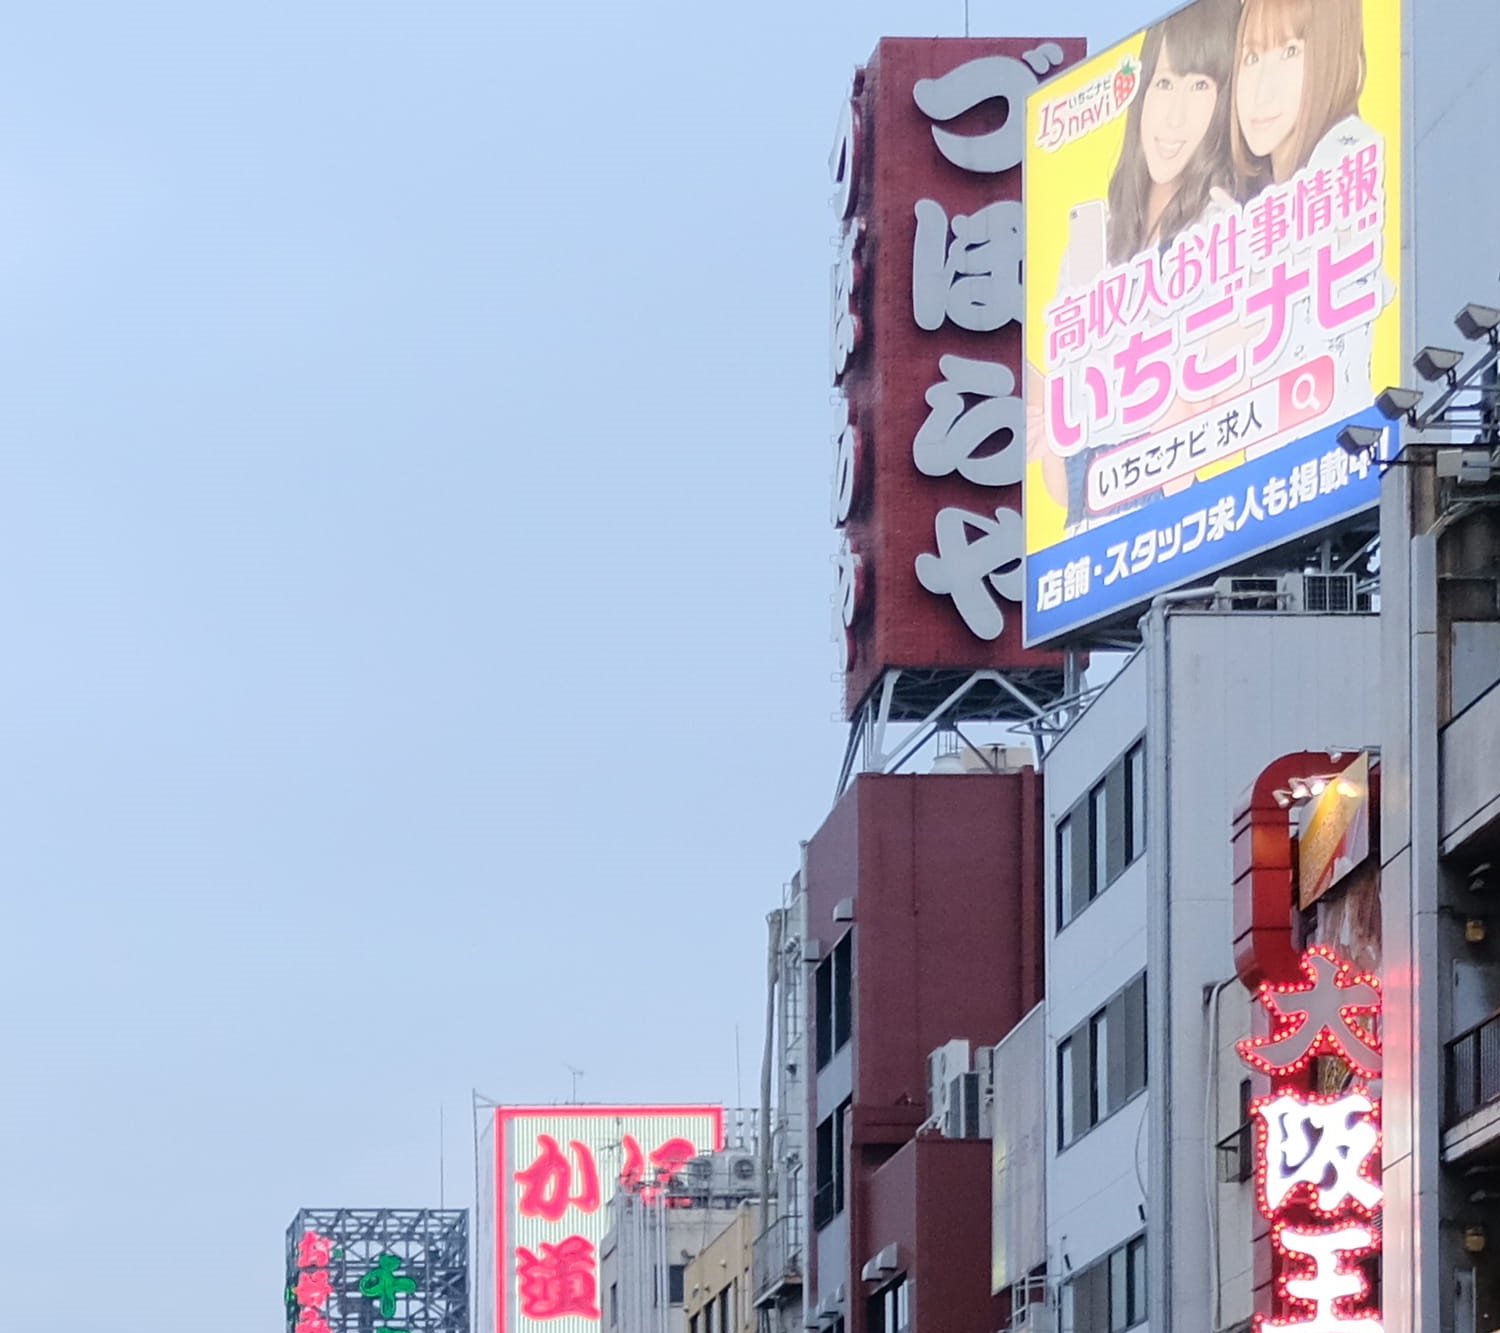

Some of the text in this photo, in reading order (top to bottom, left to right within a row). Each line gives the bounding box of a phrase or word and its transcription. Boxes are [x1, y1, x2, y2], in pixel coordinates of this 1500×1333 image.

[1067, 76, 1112, 109] いちごナビ
[1048, 145, 1380, 361] 高収入お仕事情報
[1050, 212, 1378, 450] いちごナビ
[1097, 406, 1264, 497] いちごナビ 求人
[515, 1234, 602, 1321] 道
